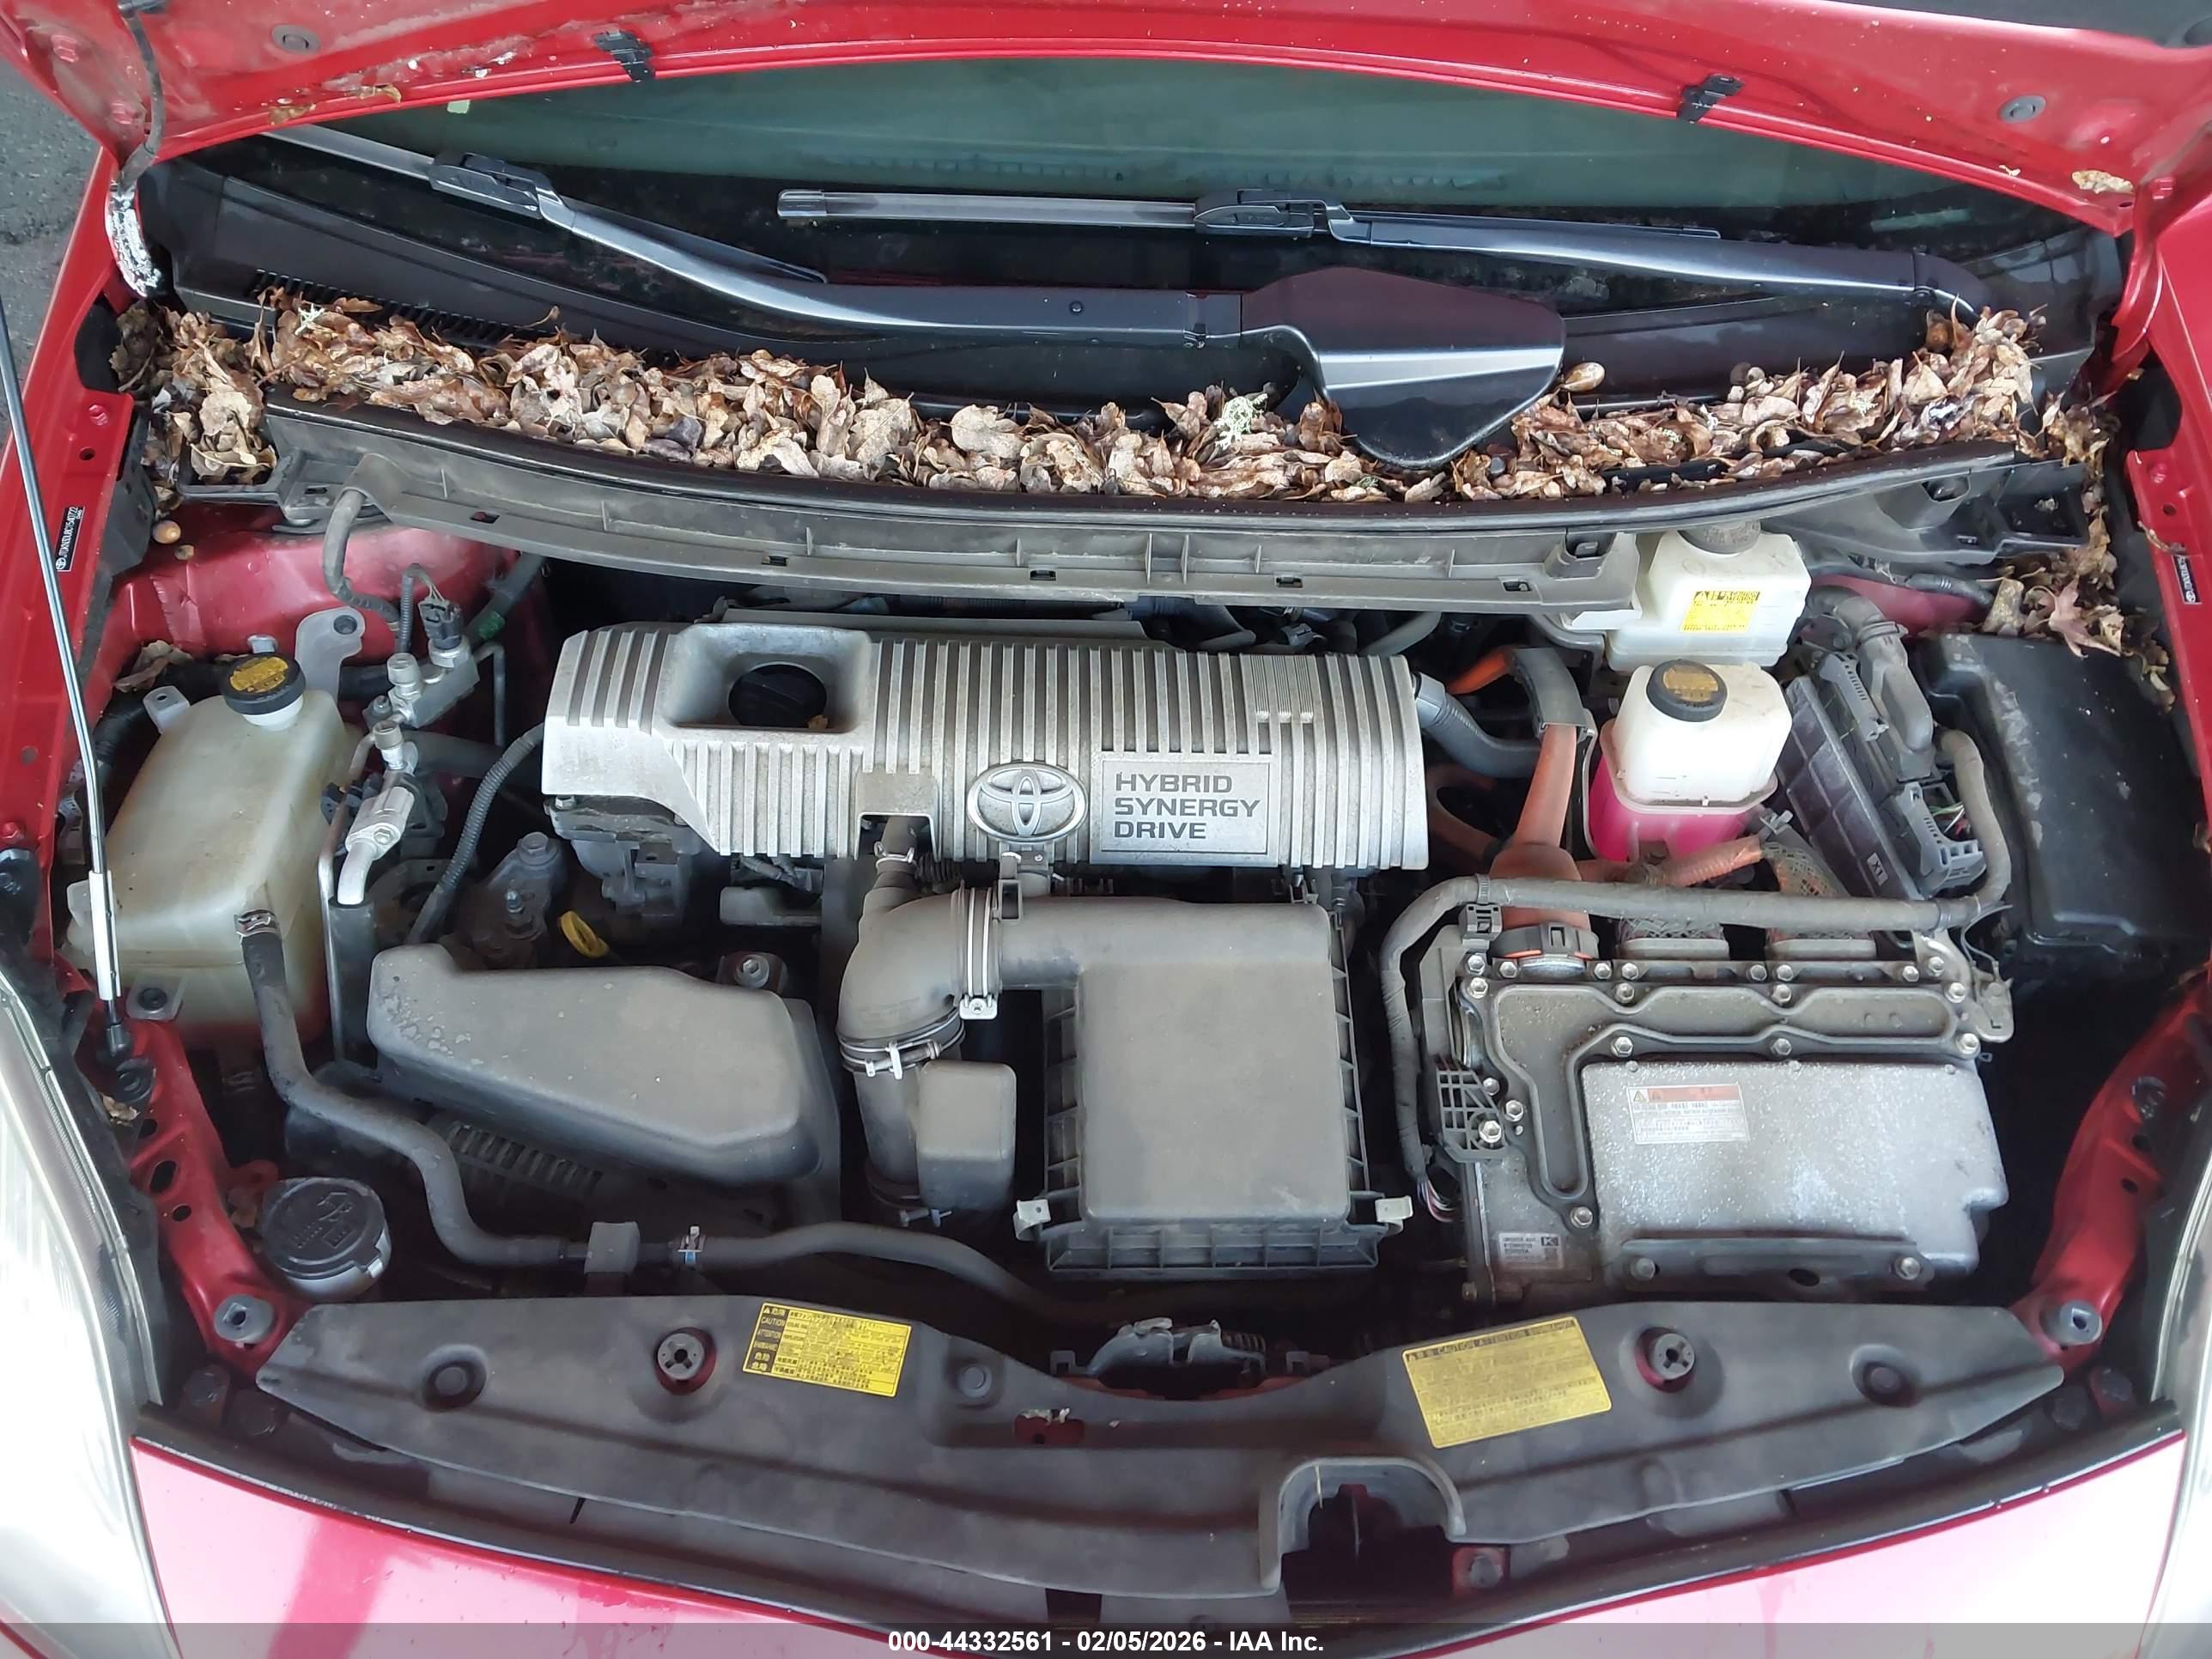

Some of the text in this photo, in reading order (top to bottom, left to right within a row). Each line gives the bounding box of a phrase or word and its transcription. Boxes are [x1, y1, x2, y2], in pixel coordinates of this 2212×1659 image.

[1115, 773, 1232, 793] HYBRID
[1115, 798, 1261, 817] SYNERGY
[1114, 821, 1206, 838] DRIVE
[761, 1316, 785, 1327] CAUTION
